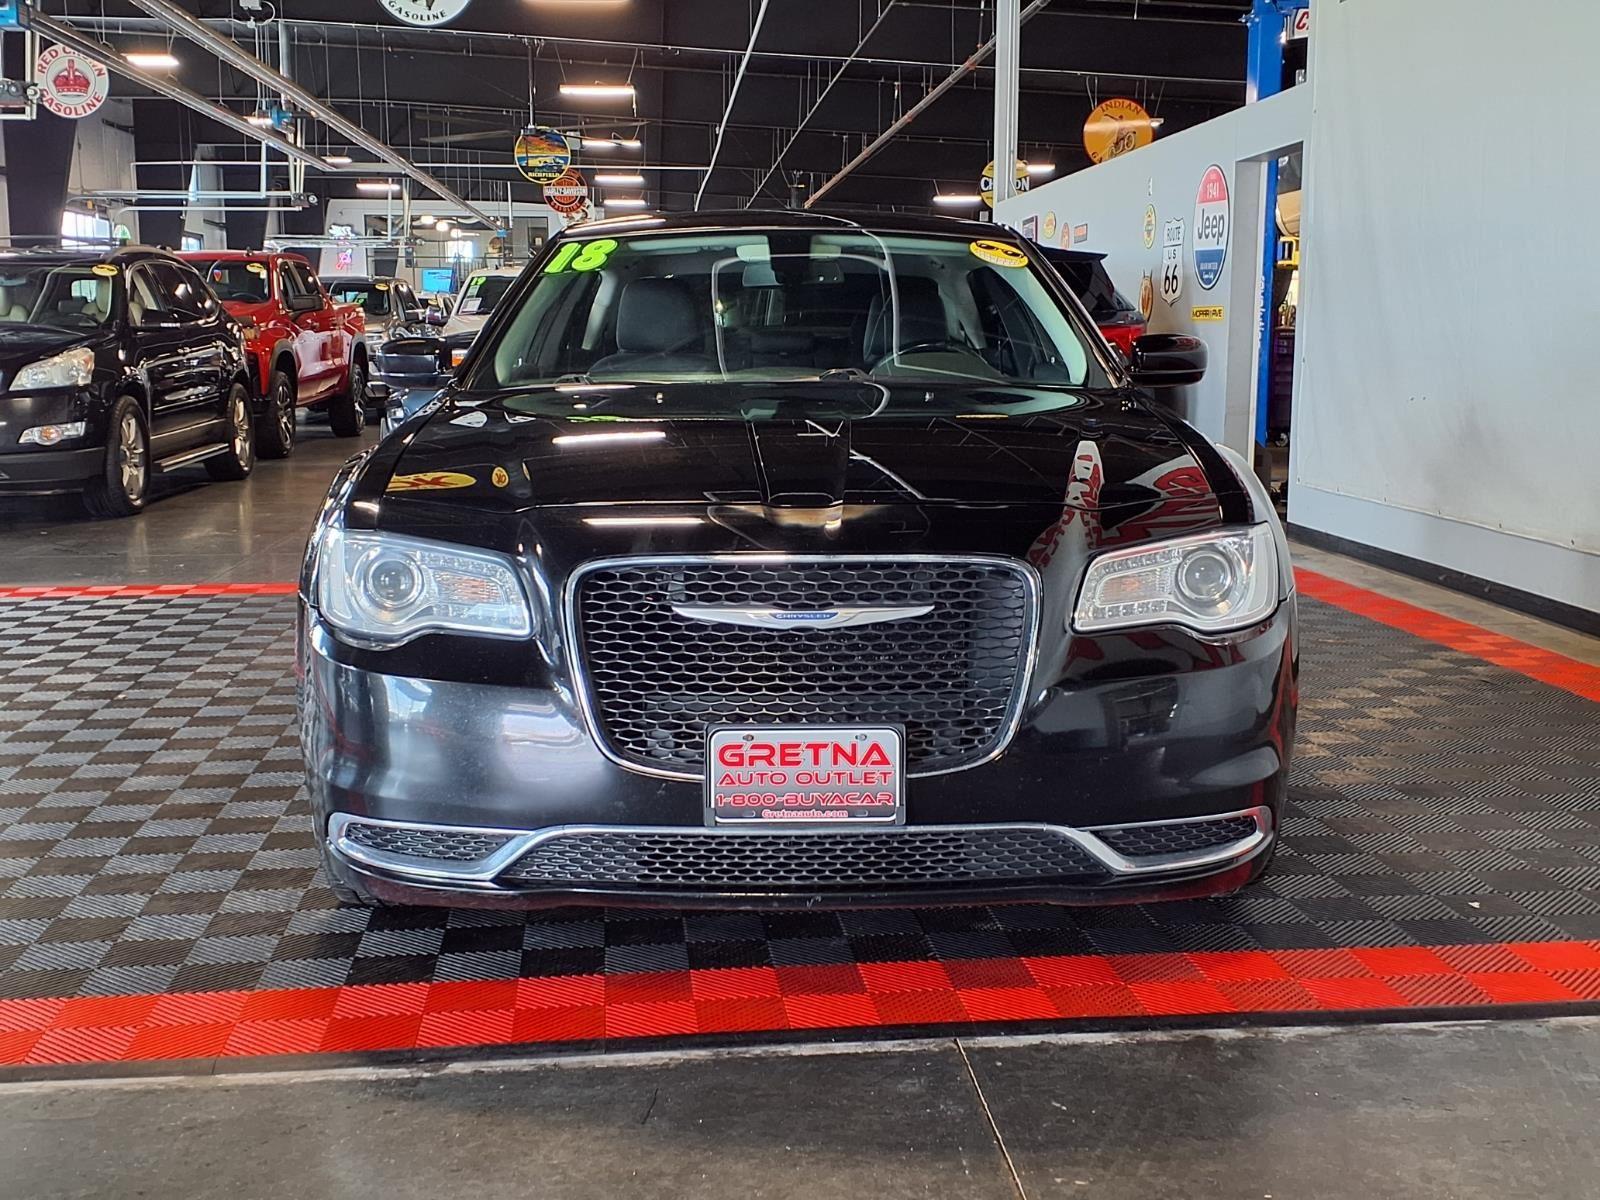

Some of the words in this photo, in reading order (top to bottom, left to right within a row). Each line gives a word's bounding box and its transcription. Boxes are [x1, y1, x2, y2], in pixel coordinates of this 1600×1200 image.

[388, 0, 447, 22] GASOLINE
[37, 48, 59, 74] RED
[39, 88, 104, 116] GASOLINE
[1100, 100, 1142, 116] INDIAN
[1206, 182, 1220, 199] 1941
[1167, 226, 1181, 241] ROUTE
[1197, 207, 1225, 245] Jeep
[543, 239, 618, 273] 18
[1164, 264, 1178, 294] 66
[717, 742, 891, 768] GRETNA
[717, 771, 788, 786] AUTO
[795, 770, 894, 786] OUTLET
[716, 792, 894, 807] 1-800-BUYACAR
[761, 808, 849, 819] Gretnaauto.com
